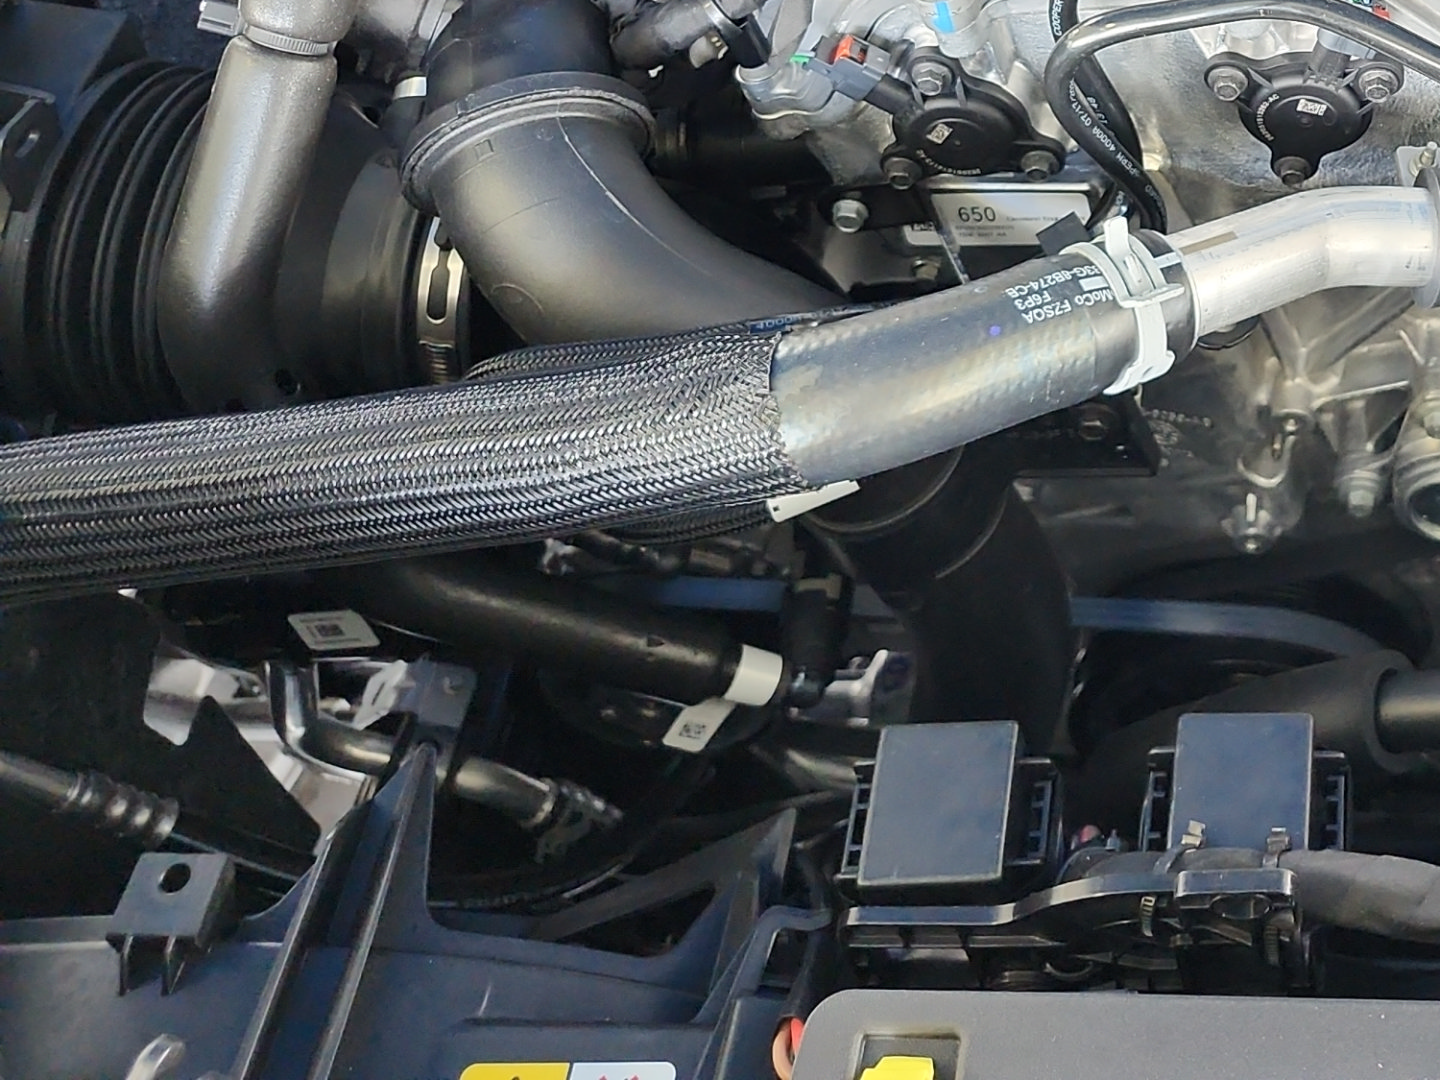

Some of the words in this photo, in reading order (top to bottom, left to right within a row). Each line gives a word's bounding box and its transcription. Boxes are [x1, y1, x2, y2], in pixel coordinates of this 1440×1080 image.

[958, 206, 996, 223] 650
[1014, 290, 1052, 311] F6P3
[1074, 288, 1114, 307] MoCo
